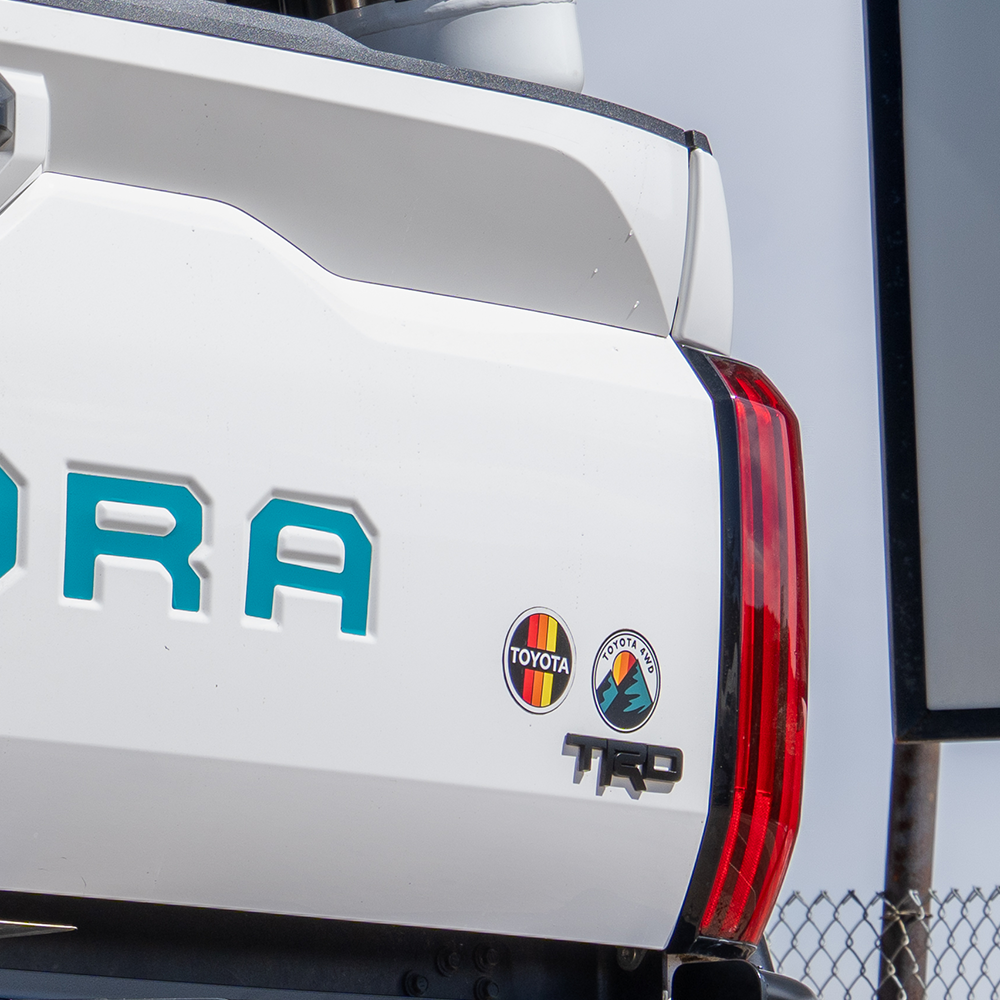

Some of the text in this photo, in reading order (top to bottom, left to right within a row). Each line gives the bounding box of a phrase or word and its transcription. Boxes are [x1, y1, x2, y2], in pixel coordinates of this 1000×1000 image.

[510, 646, 570, 675] TOYOTA
[602, 637, 655, 675] TOYOTA 4WD
[562, 733, 684, 796] TRD
